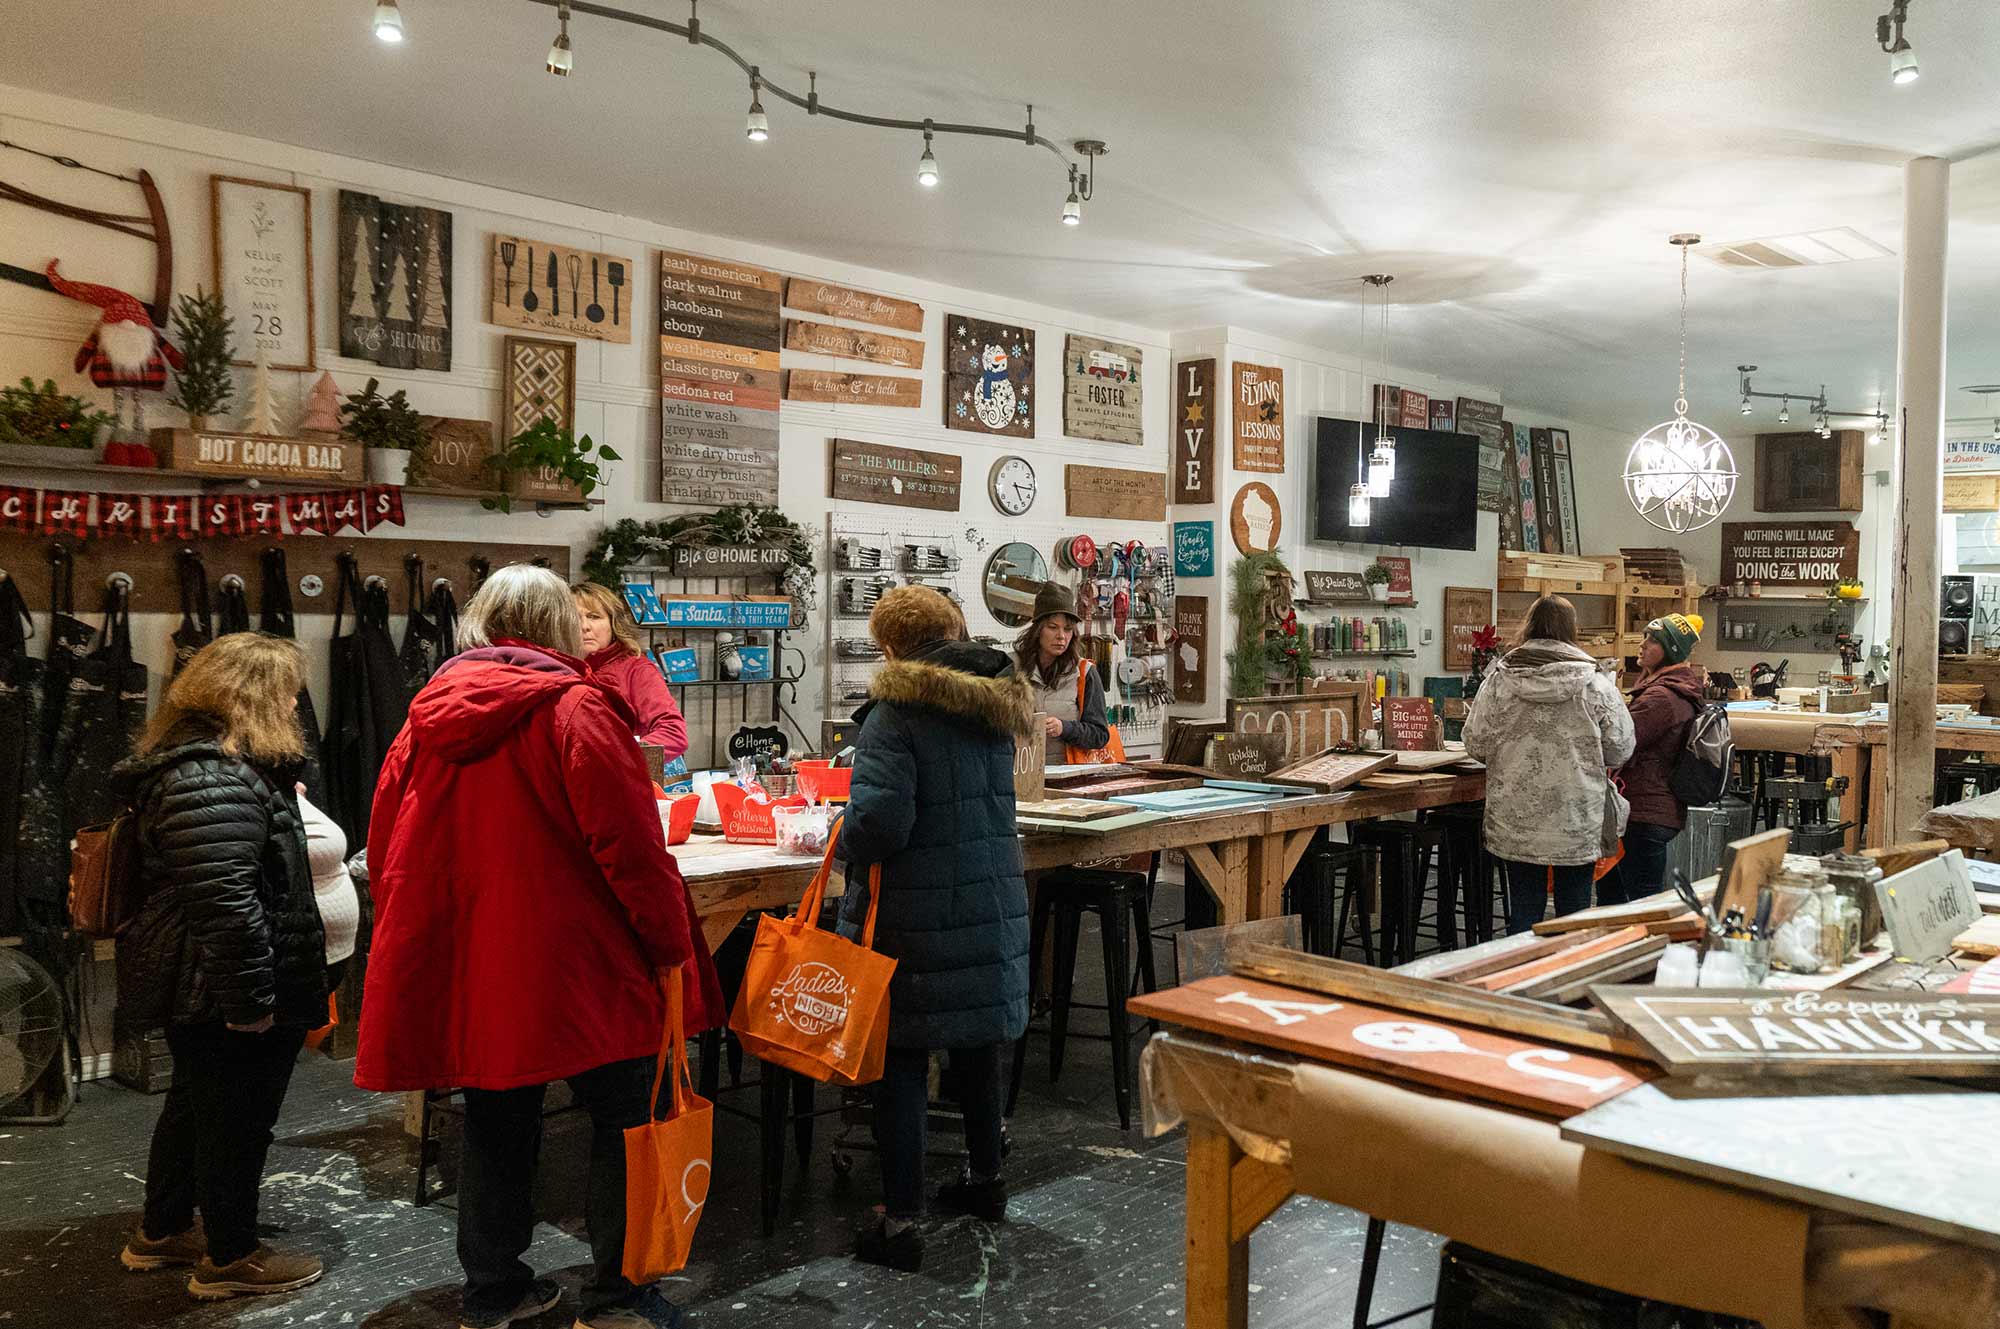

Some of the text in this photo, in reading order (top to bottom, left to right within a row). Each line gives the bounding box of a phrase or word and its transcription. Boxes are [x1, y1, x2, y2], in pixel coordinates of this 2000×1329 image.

[663, 258, 761, 284] early american
[244, 276, 284, 289] SCOTT
[663, 277, 743, 301] dark walnut
[252, 300, 280, 312] MAY
[663, 296, 723, 318] jacobean
[816, 286, 838, 302] Our
[839, 291, 867, 308] Love
[867, 297, 899, 321] Story
[251, 313, 283, 336] 28
[663, 319, 704, 337] ebony
[663, 342, 757, 364] weathered oak
[815, 335, 856, 350] HAPPILY
[881, 347, 910, 361] AFTER
[663, 360, 740, 383] classic grey
[1242, 370, 1258, 385] FREE
[664, 384, 734, 401] sedona red
[812, 379, 823, 392] to
[824, 381, 848, 393] have
[850, 380, 863, 395] &
[864, 382, 875, 395] to
[875, 379, 899, 397] hold
[1088, 384, 1126, 408] FOSTER
[1241, 379, 1280, 406] FLYING
[665, 405, 737, 422] white wash
[664, 424, 729, 439] grey wash
[1241, 421, 1281, 441] LESSONS
[200, 438, 343, 470] HOT COCOA BAR
[432, 440, 473, 468] JOY
[663, 444, 762, 463] white dry brush
[1947, 442, 1958, 452] IN
[1960, 442, 1979, 452] THE
[663, 465, 756, 482] grey dry brush
[859, 454, 938, 476] THE MILLERS
[882, 479, 888, 488] N
[949, 486, 957, 496] W
[1113, 479, 1125, 487] THE
[1125, 480, 1146, 489] MONTH
[1540, 454, 1555, 527] HELLO
[664, 485, 763, 502] khaki dry brush
[1559, 460, 1573, 543] WELCOME
[2, 494, 391, 526] CHRISTMAS
[1744, 530, 1834, 541] NOTHING WILL MAKE
[705, 548, 759, 563] @HOME
[761, 549, 789, 563] KITS
[1734, 546, 1845, 558] YOU FEEL BETTER EXCEPT
[1736, 562, 1840, 580] DOING the WORK
[1325, 576, 1346, 589] Paint
[1346, 576, 1362, 589] Bar
[685, 605, 726, 624] Santa,
[745, 607, 763, 615] BEEN
[765, 607, 788, 615] EXTRA
[1179, 612, 1202, 625] DRINK
[749, 616, 764, 625] THIS
[765, 616, 786, 625] YEAR!
[1178, 624, 1201, 637] LOCAL
[1392, 711, 1409, 721] BIG
[1392, 721, 1427, 730] SHAPE LITTLE
[1397, 730, 1424, 738] MINDS
[735, 734, 774, 748] @Home
[1013, 746, 1036, 775] JOY
[1228, 746, 1259, 765] Holiday
[1240, 759, 1266, 774] Cheers!
[733, 808, 768, 825] Merry
[729, 821, 773, 834] Christmas
[797, 993, 847, 1024] NIGHT
[799, 1015, 827, 1034] OUT
[1675, 1016, 2000, 1050] HANUKK
